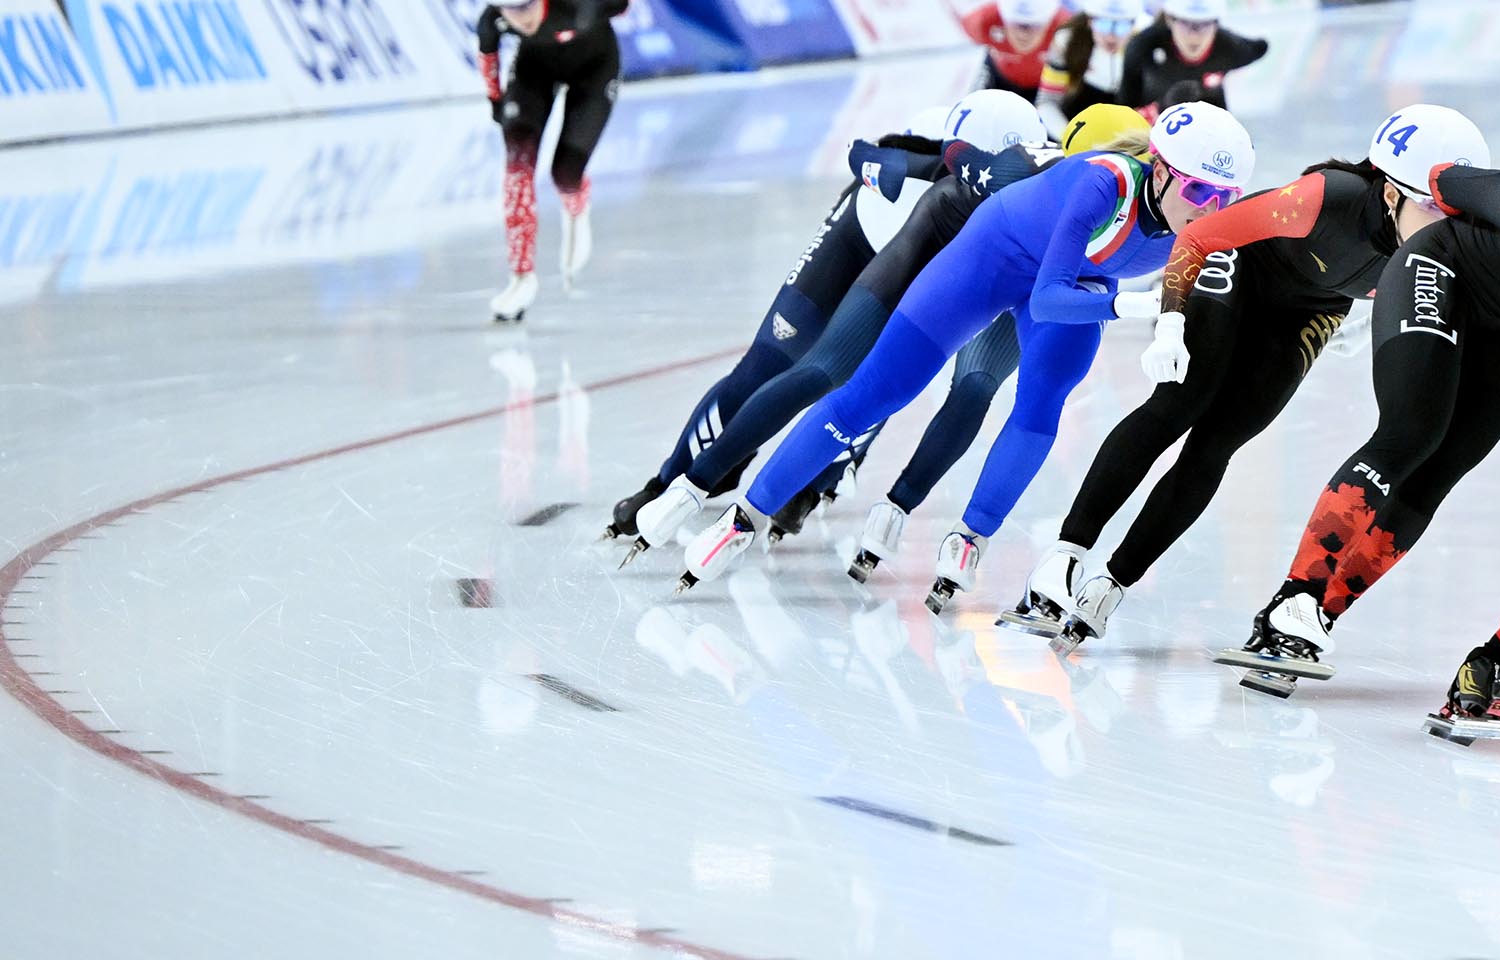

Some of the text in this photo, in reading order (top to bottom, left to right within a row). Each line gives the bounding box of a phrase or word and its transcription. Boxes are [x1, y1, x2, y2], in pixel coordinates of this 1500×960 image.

[0, 14, 86, 94] KIN
[1065, 120, 1087, 150] 1
[1161, 106, 1194, 136] 13
[1376, 114, 1419, 157] 14
[824, 421, 851, 444] FILA
[1352, 461, 1391, 497] FILA
